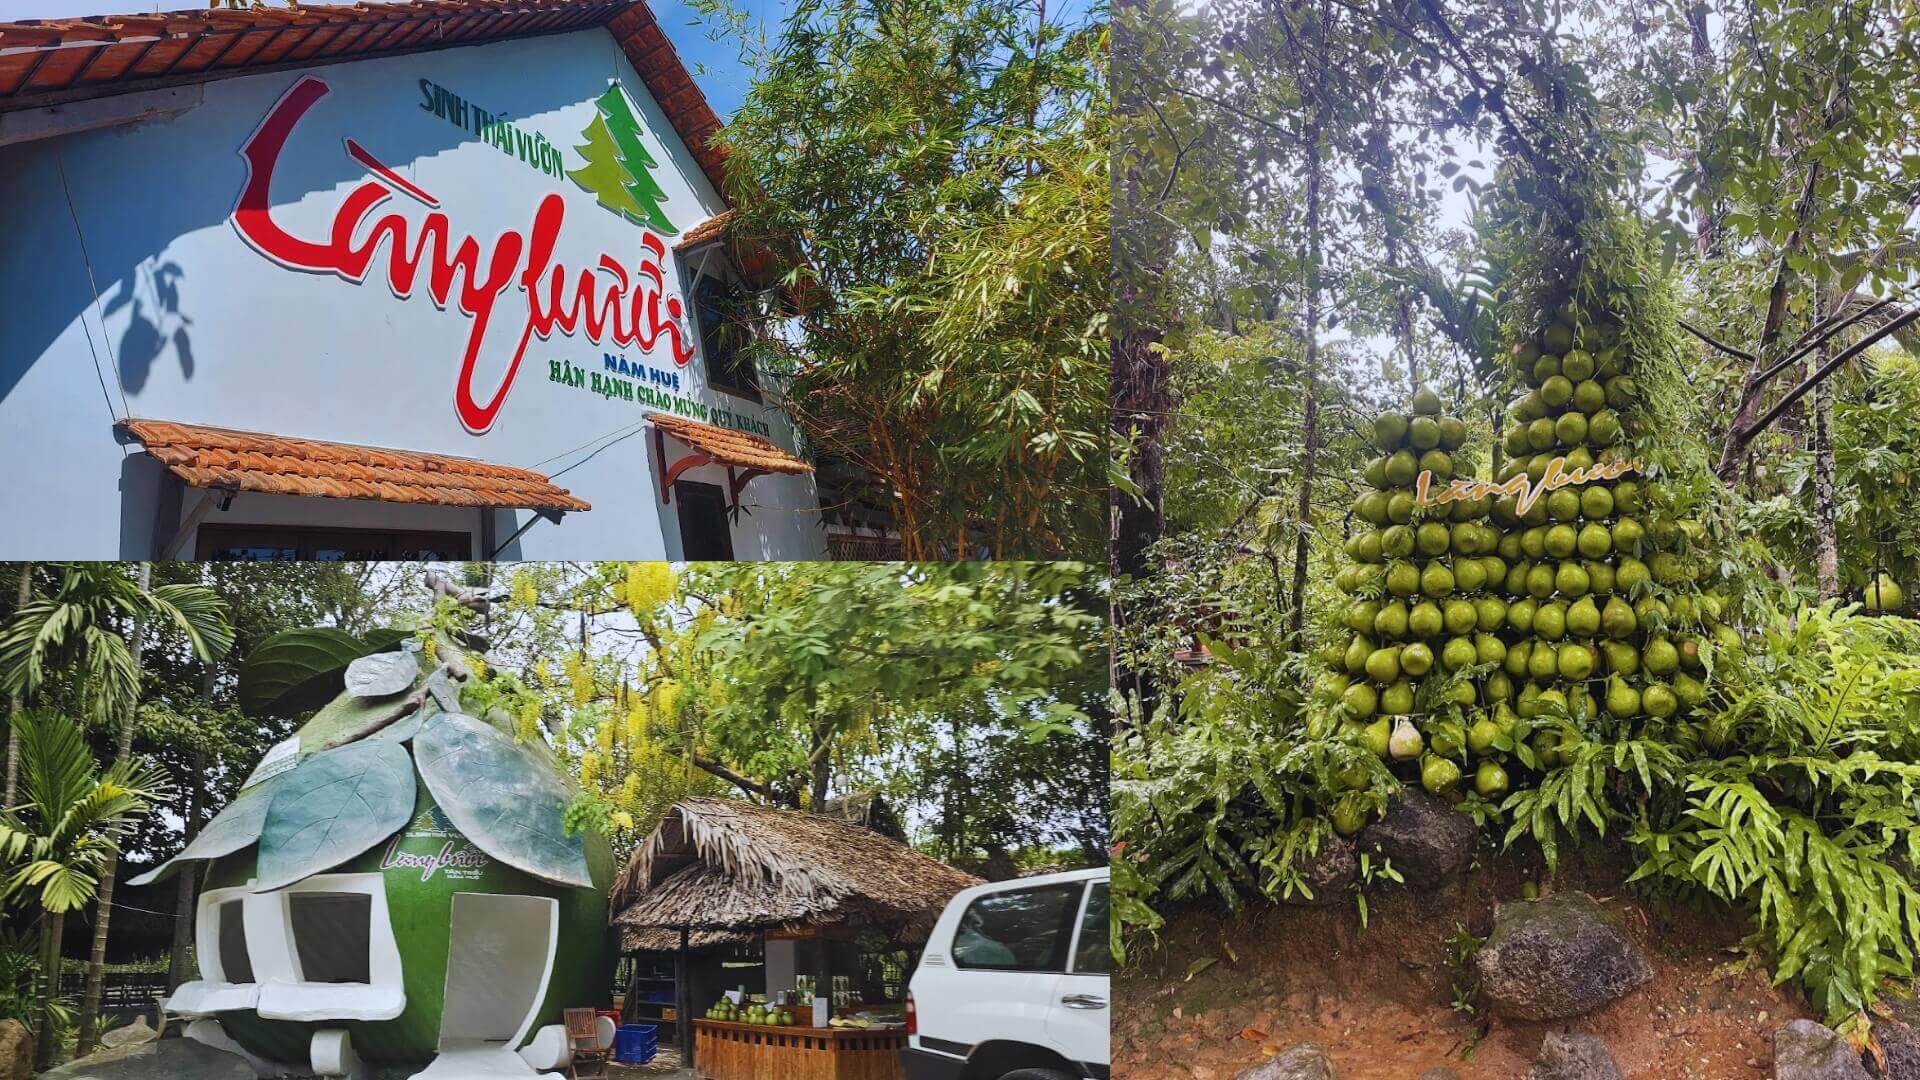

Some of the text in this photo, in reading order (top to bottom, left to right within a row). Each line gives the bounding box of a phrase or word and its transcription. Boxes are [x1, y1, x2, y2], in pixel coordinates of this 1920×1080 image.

[516, 130, 564, 181] VƯỜN
[603, 353, 681, 392] NĂM HUỆ
[549, 359, 585, 389] HÂN
[591, 371, 634, 402] HẠNH
[637, 385, 672, 411] CHÀO
[711, 406, 733, 428] QUÝ
[736, 412, 770, 438] KHÁCH
